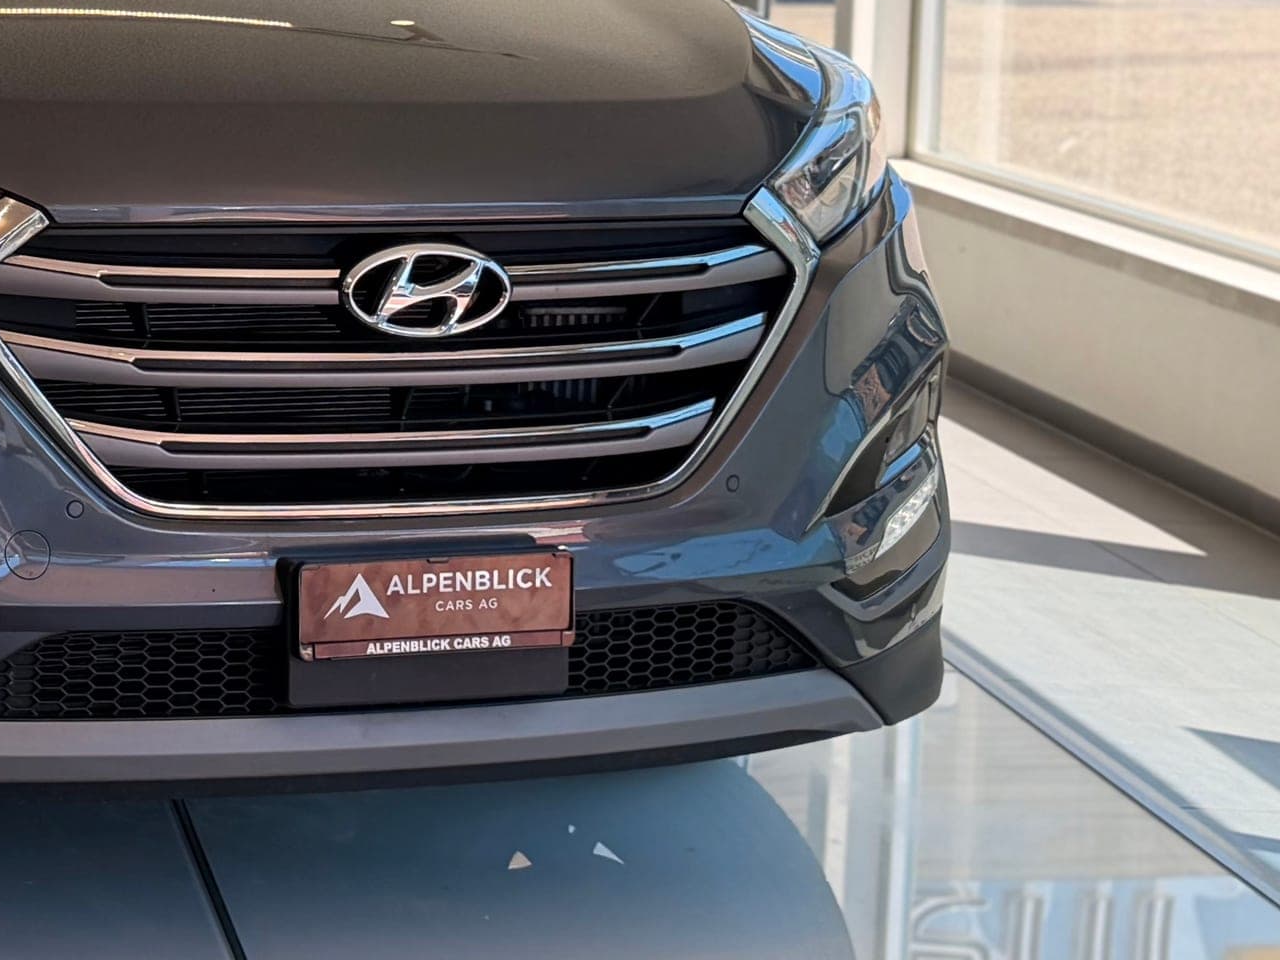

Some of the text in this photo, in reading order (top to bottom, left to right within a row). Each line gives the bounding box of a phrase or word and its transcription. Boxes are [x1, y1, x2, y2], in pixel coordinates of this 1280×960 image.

[386, 566, 553, 596] ALPENBLICK
[435, 597, 499, 613] CARS AG
[366, 634, 512, 655] ALPENBLICK CARS AG
